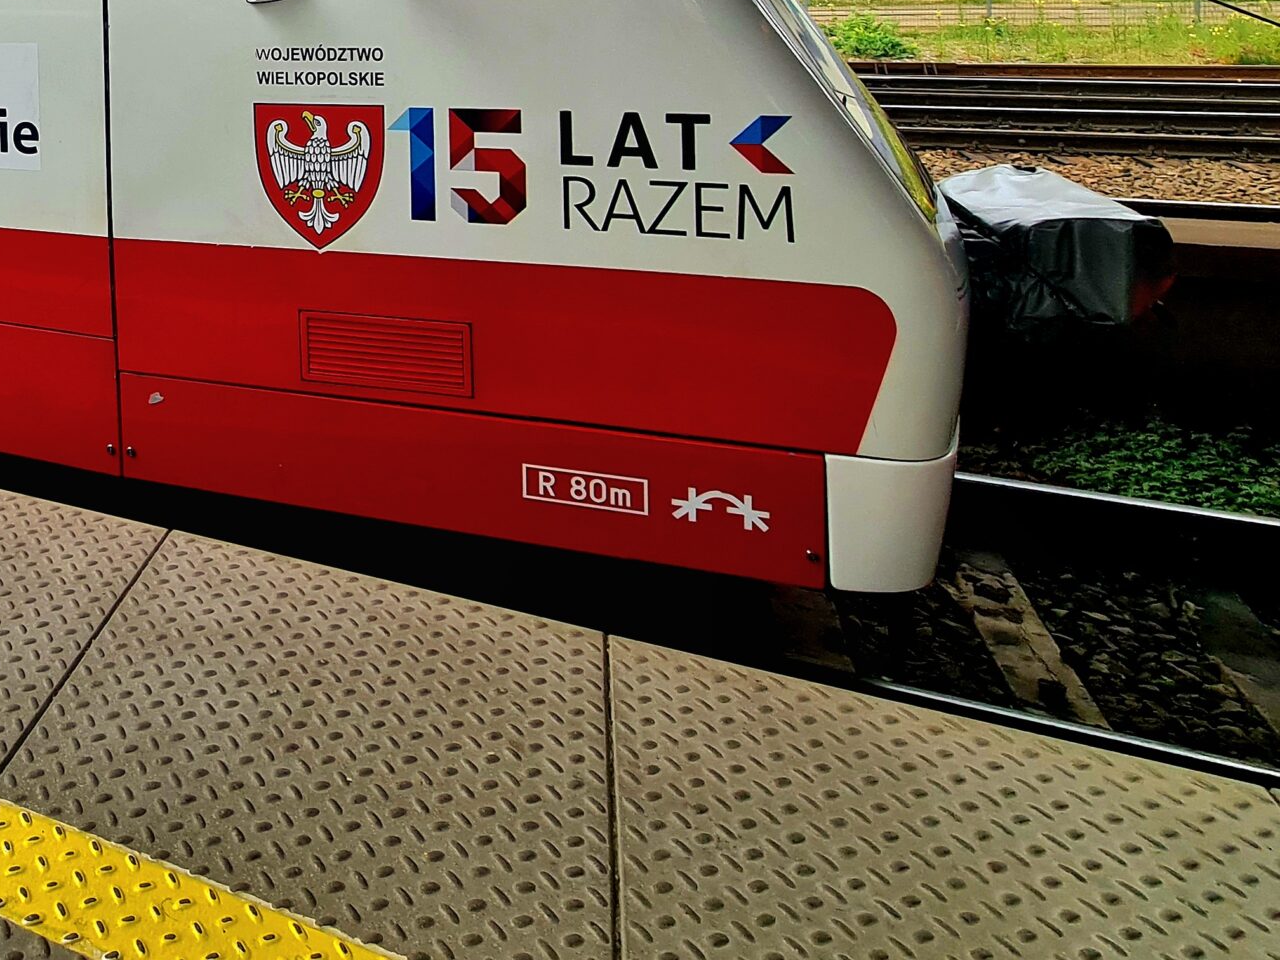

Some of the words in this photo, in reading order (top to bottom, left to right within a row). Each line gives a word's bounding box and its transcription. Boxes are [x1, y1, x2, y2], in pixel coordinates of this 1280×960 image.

[255, 44, 384, 62] WOJEWÓDZTWO
[256, 71, 385, 86] WIELKOPOLSKIE
[387, 107, 527, 225] 15
[559, 110, 711, 171] LAT
[562, 175, 796, 243] RAZEM
[538, 471, 556, 497] R
[570, 476, 632, 508] 80m
